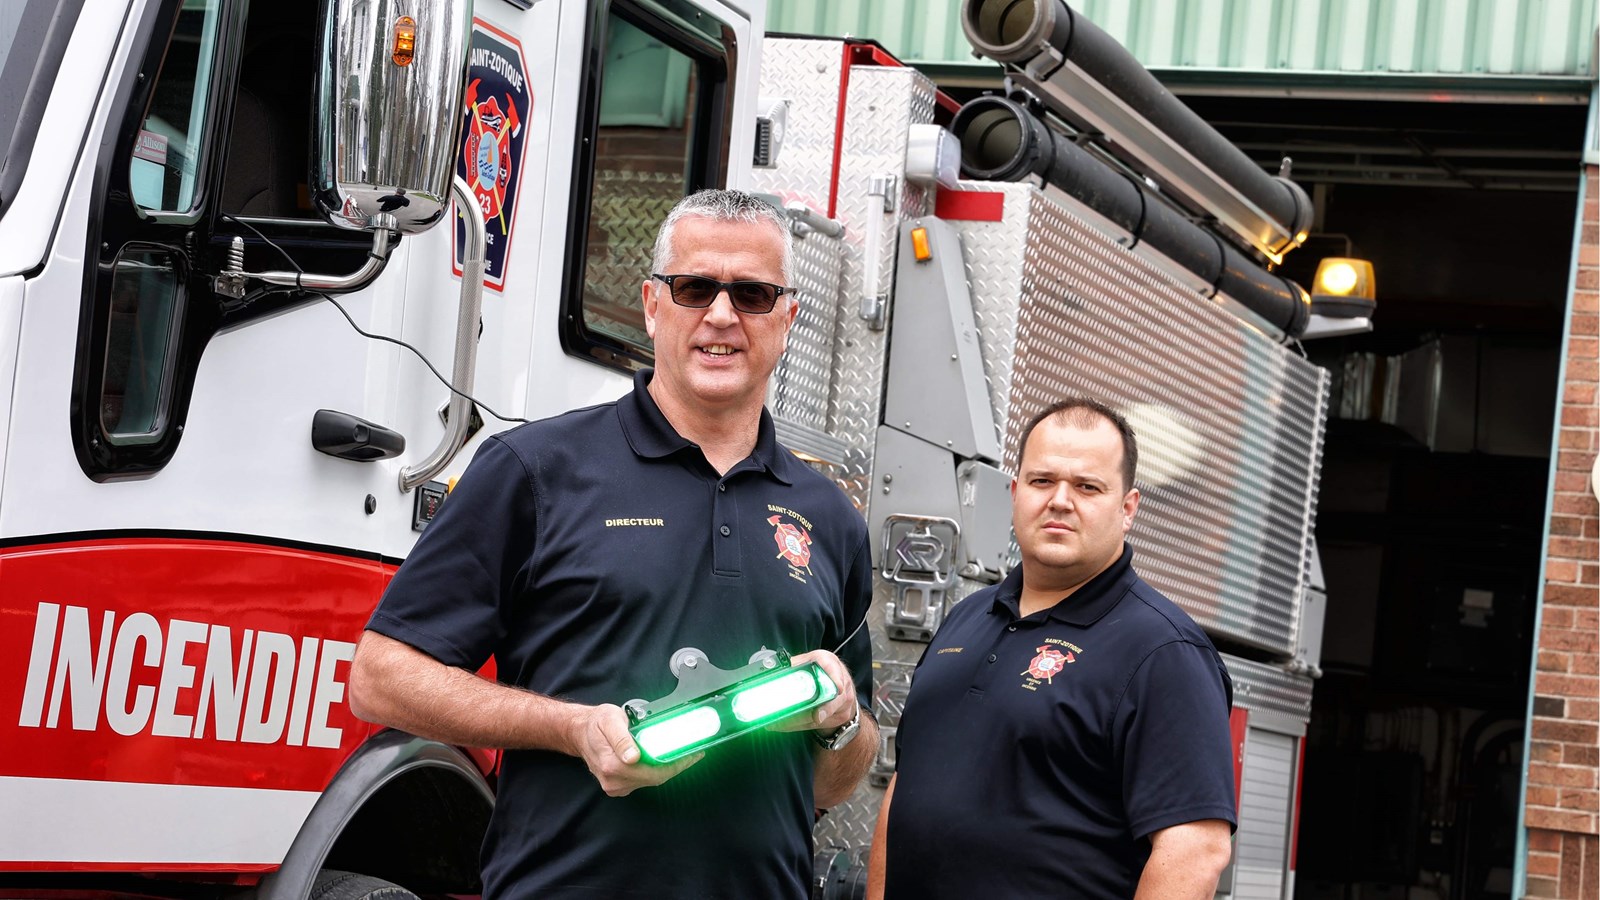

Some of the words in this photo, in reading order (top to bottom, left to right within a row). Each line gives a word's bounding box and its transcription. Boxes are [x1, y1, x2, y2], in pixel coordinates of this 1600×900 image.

[470, 47, 523, 94] AINT-ZOTIQUE
[480, 193, 491, 214] 23
[605, 518, 664, 527] DIRECTEUR
[767, 504, 813, 531] SAINT-ZOTIQUE
[1045, 637, 1083, 654] SAINT-ZOTIQUE
[18, 601, 357, 749] INCENDIE
